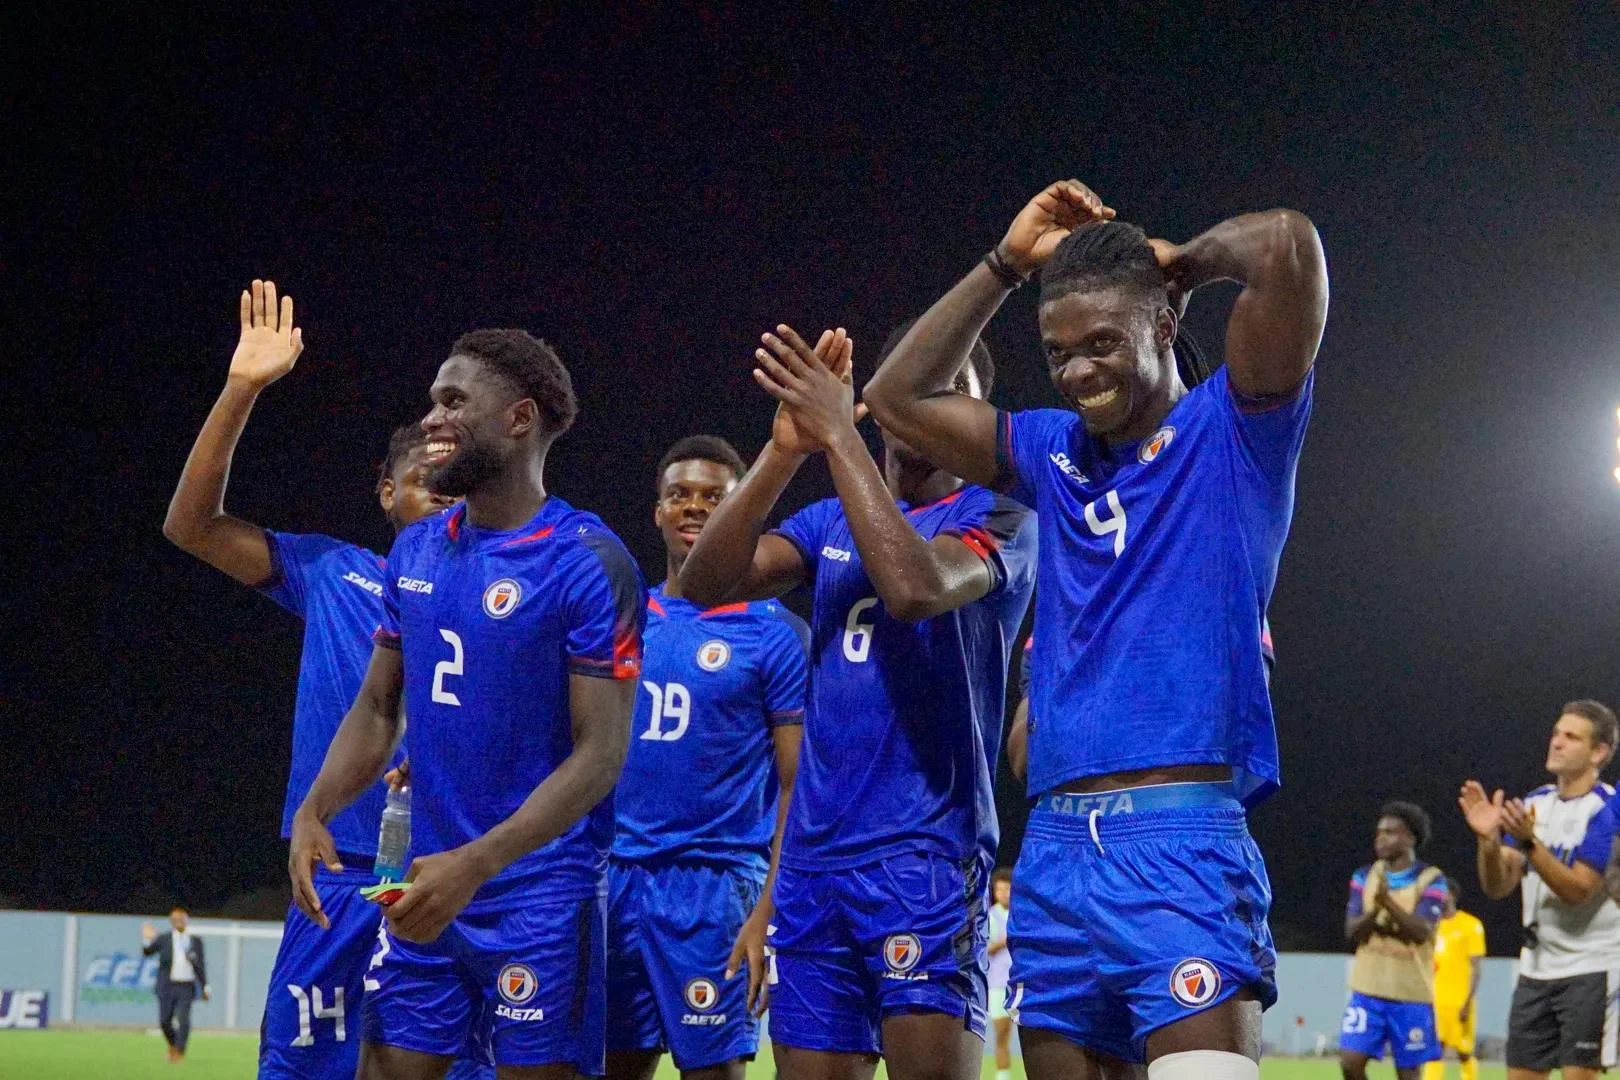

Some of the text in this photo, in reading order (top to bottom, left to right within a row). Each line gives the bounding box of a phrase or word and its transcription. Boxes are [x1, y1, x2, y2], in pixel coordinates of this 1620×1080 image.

[1083, 489, 1127, 559] 9
[342, 571, 383, 597] SAET
[842, 597, 878, 663] 6
[431, 628, 464, 706] 2
[639, 680, 691, 742] 19
[289, 983, 346, 1048] 14
[494, 1004, 544, 1021] SAETA
[680, 1014, 727, 1026] SAETA
